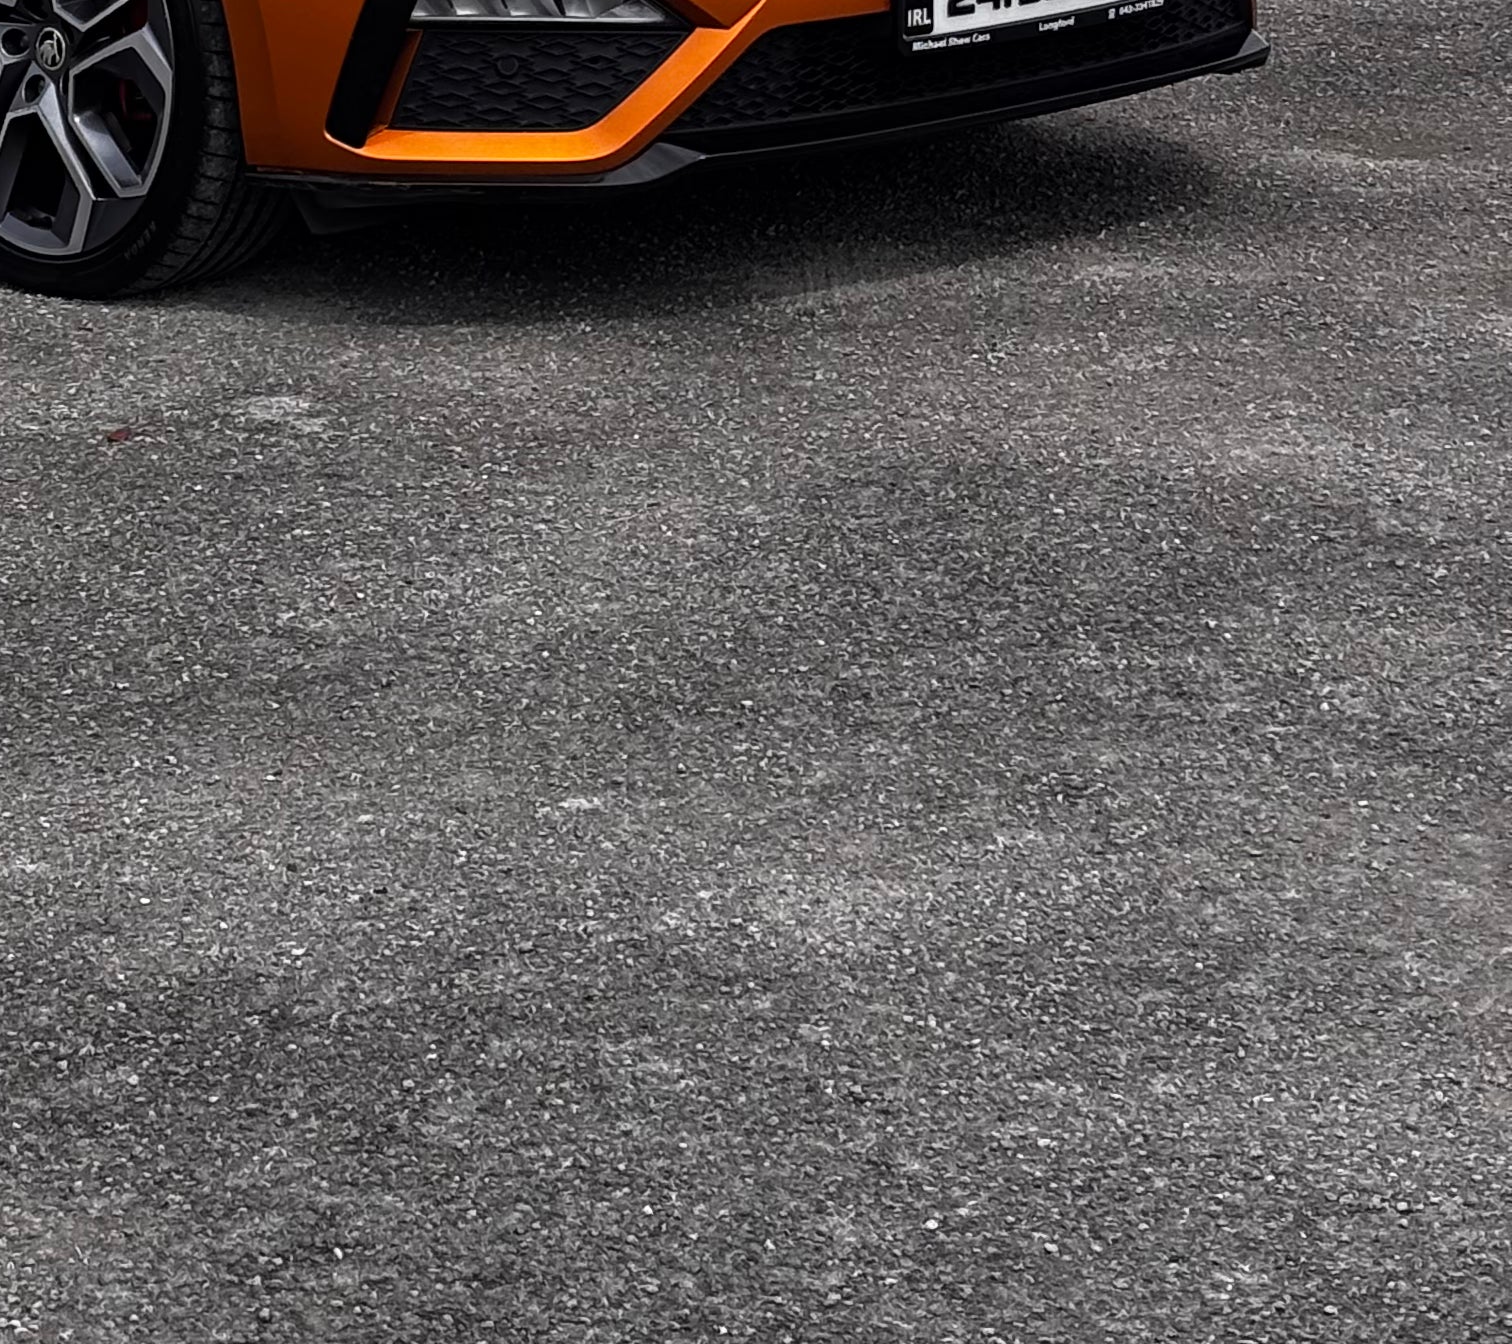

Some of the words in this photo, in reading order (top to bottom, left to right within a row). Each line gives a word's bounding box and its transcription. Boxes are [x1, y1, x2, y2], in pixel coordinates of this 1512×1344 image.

[907, 8, 932, 27] IRL
[1038, 15, 1076, 32] Longford
[912, 37, 947, 52] Michael
